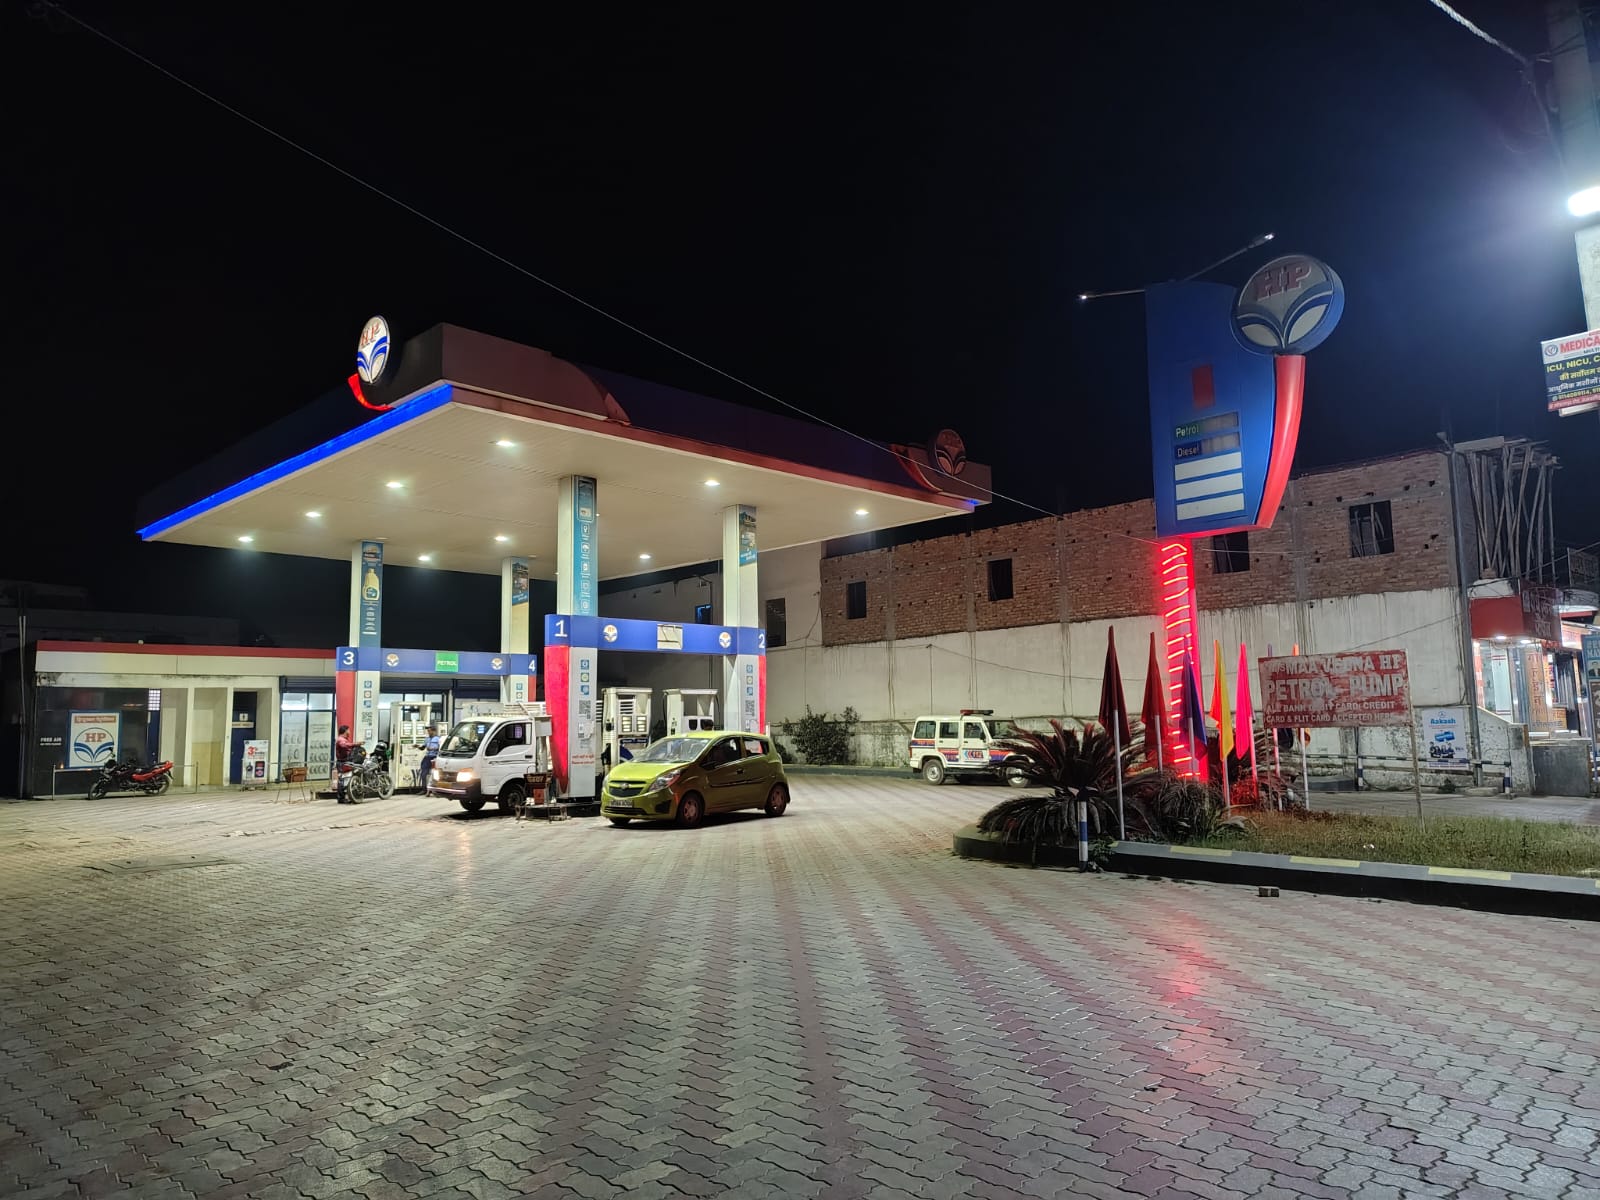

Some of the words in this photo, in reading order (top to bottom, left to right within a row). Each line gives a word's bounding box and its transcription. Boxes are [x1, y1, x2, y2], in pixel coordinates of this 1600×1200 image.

[1254, 263, 1312, 301] HP
[361, 321, 380, 348] HP
[1566, 357, 1592, 369] NICU,
[1175, 424, 1199, 439] Petrol
[1177, 444, 1200, 458] Diesel
[555, 619, 568, 638] 1
[758, 633, 766, 649] 2
[343, 651, 354, 666] 3
[528, 659, 536, 672] 4
[1379, 654, 1402, 670] HP
[1350, 674, 1404, 697] PUMP
[1363, 701, 1397, 710] CREDIT
[1266, 715, 1286, 723] CARD
[1310, 714, 1330, 722] CARD
[85, 732, 107, 743] HP
